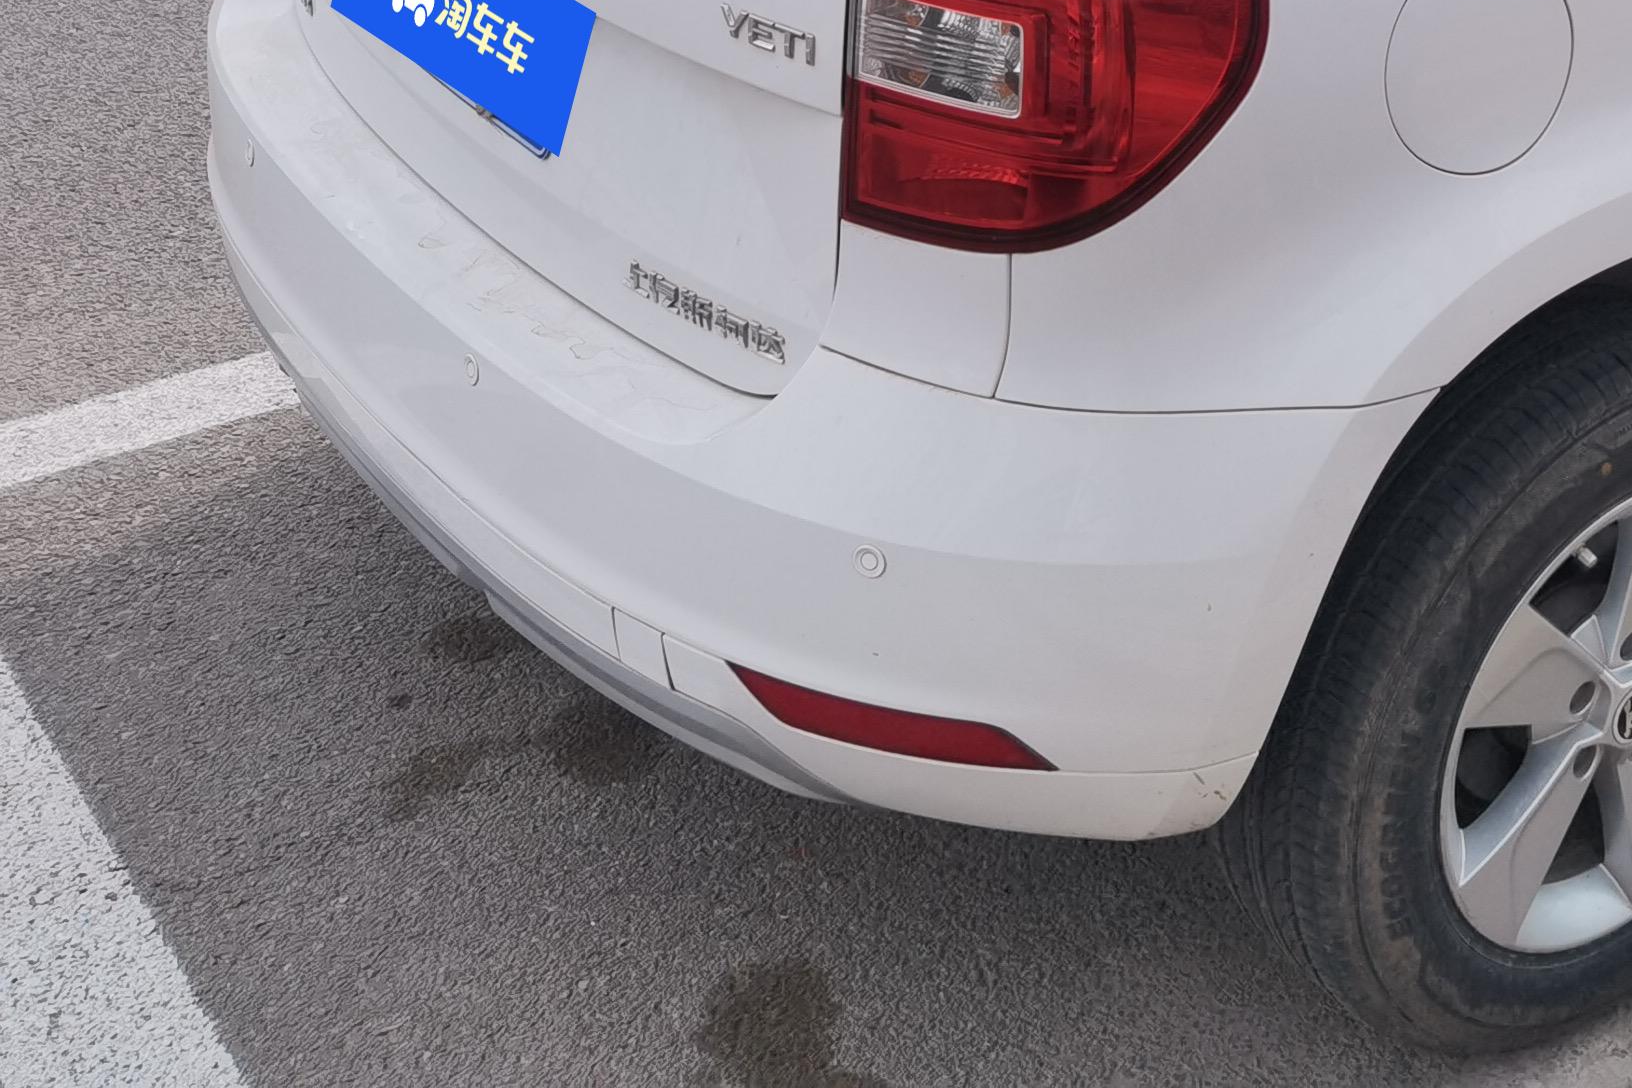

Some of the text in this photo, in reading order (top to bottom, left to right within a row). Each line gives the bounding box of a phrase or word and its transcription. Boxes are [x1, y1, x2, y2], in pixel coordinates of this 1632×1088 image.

[720, 3, 816, 67] YETI
[622, 259, 785, 364] 上汽斯柯达
